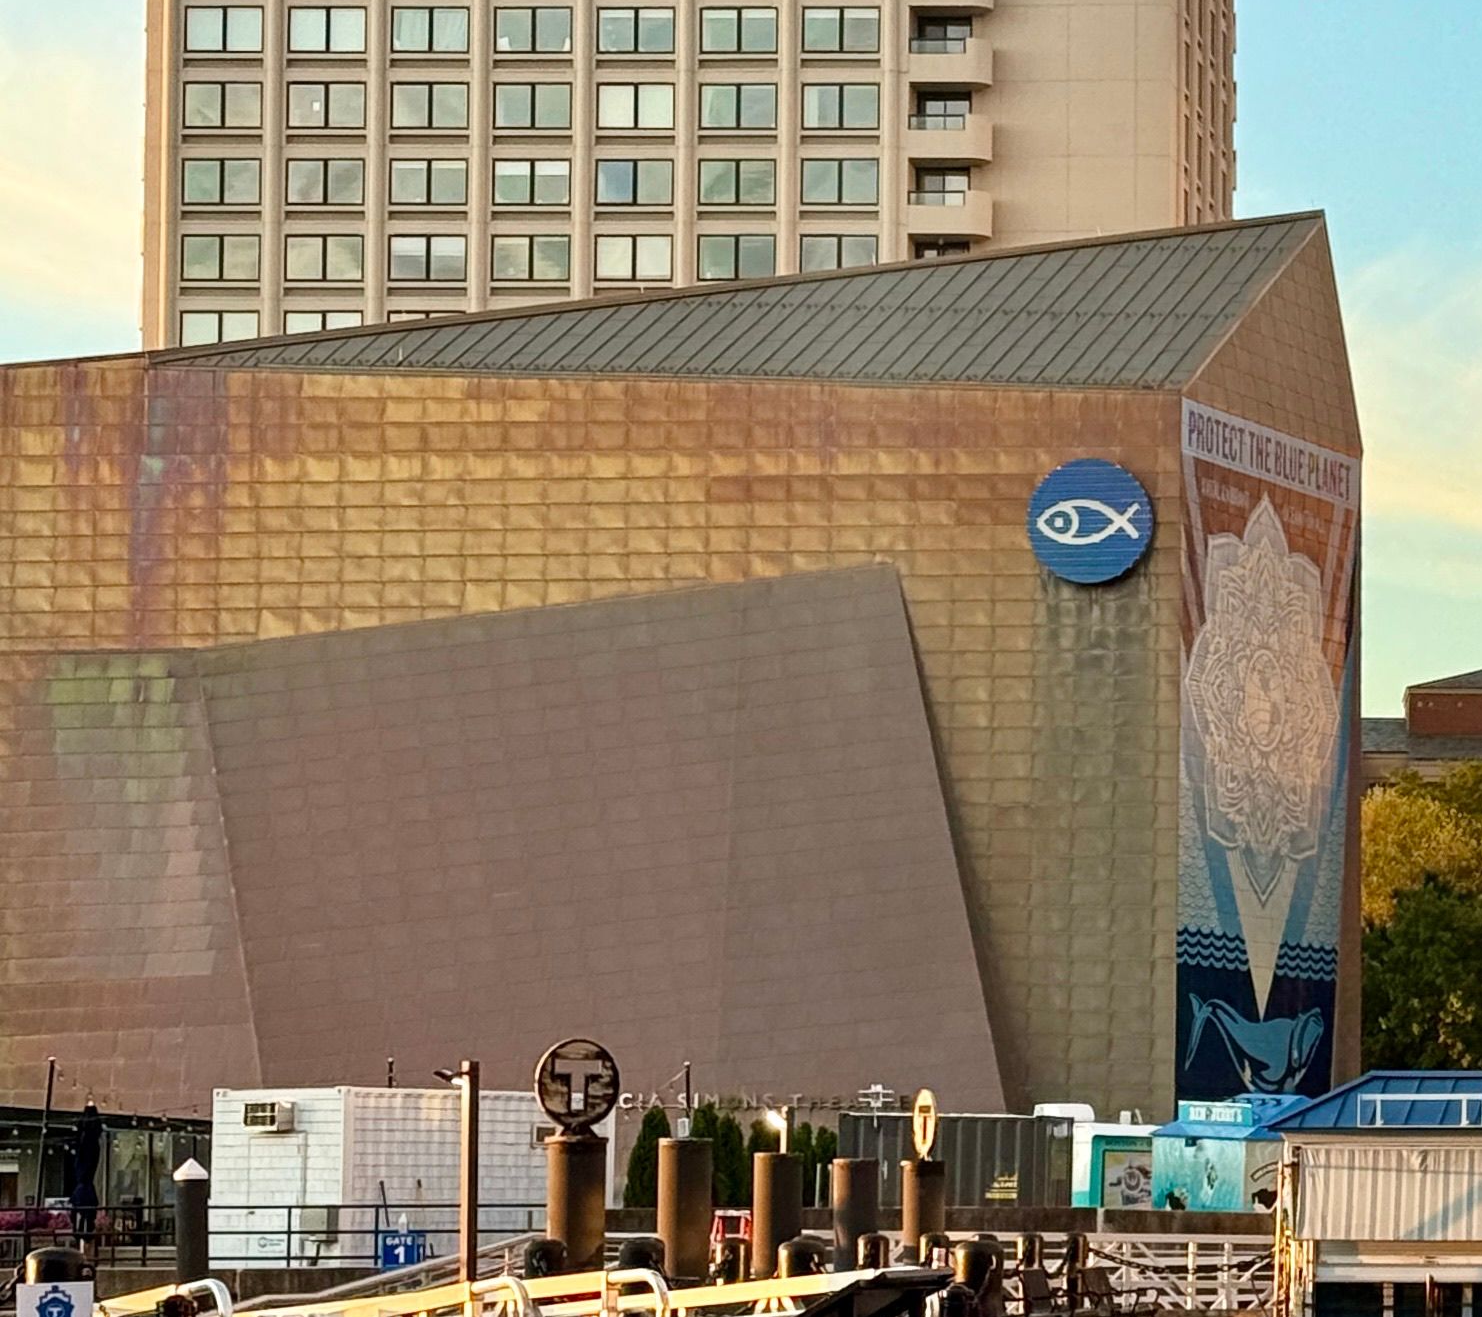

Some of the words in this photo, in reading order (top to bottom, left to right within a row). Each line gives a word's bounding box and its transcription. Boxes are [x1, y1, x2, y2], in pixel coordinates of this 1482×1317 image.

[1188, 411, 1244, 463] PROTECT
[1248, 432, 1271, 474] THE
[1275, 440, 1305, 484] BLUE
[1308, 452, 1351, 501] PLANET
[554, 1058, 603, 1115] T
[385, 1236, 412, 1245] GATE
[394, 1245, 405, 1263] 1
